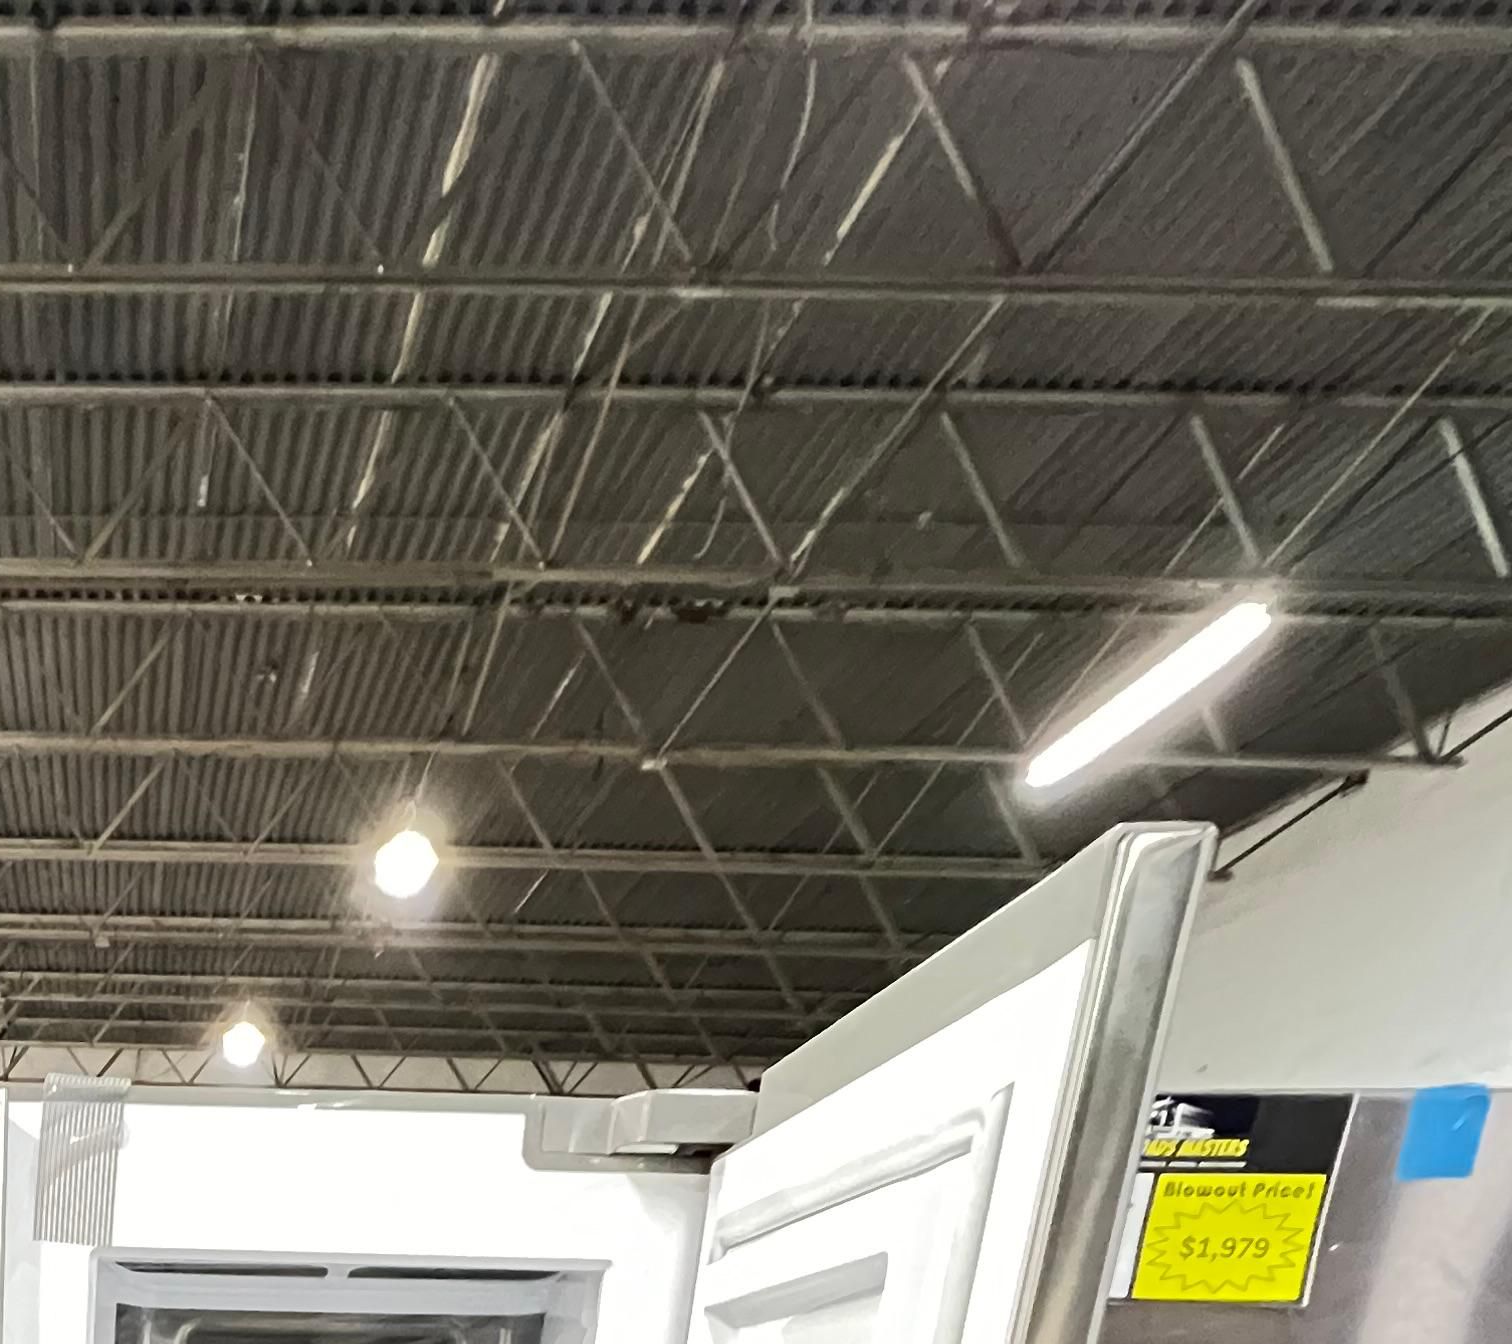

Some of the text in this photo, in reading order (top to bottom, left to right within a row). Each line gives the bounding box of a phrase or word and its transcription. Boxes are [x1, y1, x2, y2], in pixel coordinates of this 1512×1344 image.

[1163, 1180, 1316, 1200] Blowout Price!
[1179, 1235, 1271, 1262] $1,979
